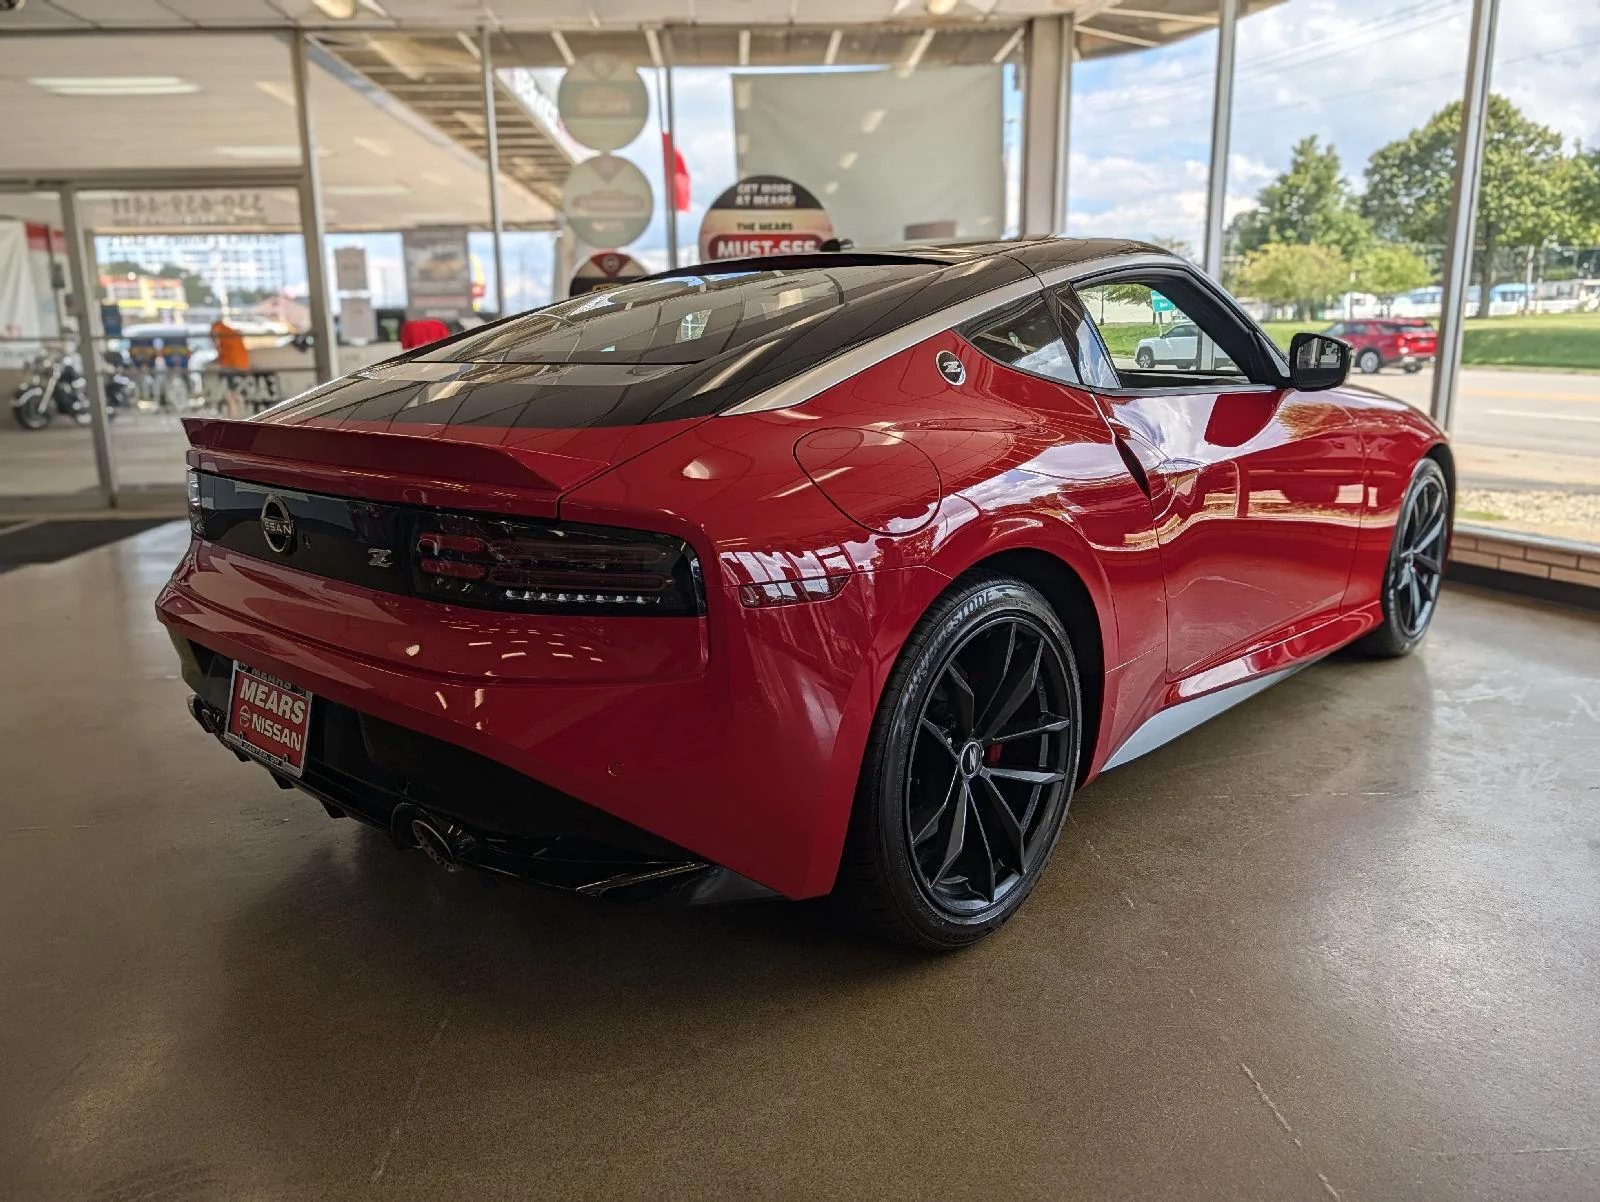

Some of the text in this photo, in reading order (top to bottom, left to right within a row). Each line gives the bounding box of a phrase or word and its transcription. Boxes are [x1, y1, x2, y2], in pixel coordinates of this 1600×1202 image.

[736, 183, 793, 194] GET MORE
[735, 195, 752, 206] AT
[736, 223, 793, 231] THE MEARS
[717, 240, 817, 258] MUST-SEE
[943, 361, 961, 373] Z
[368, 548, 392, 568] Z
[240, 678, 306, 725] MEARS
[252, 713, 302, 752] NISSAN
